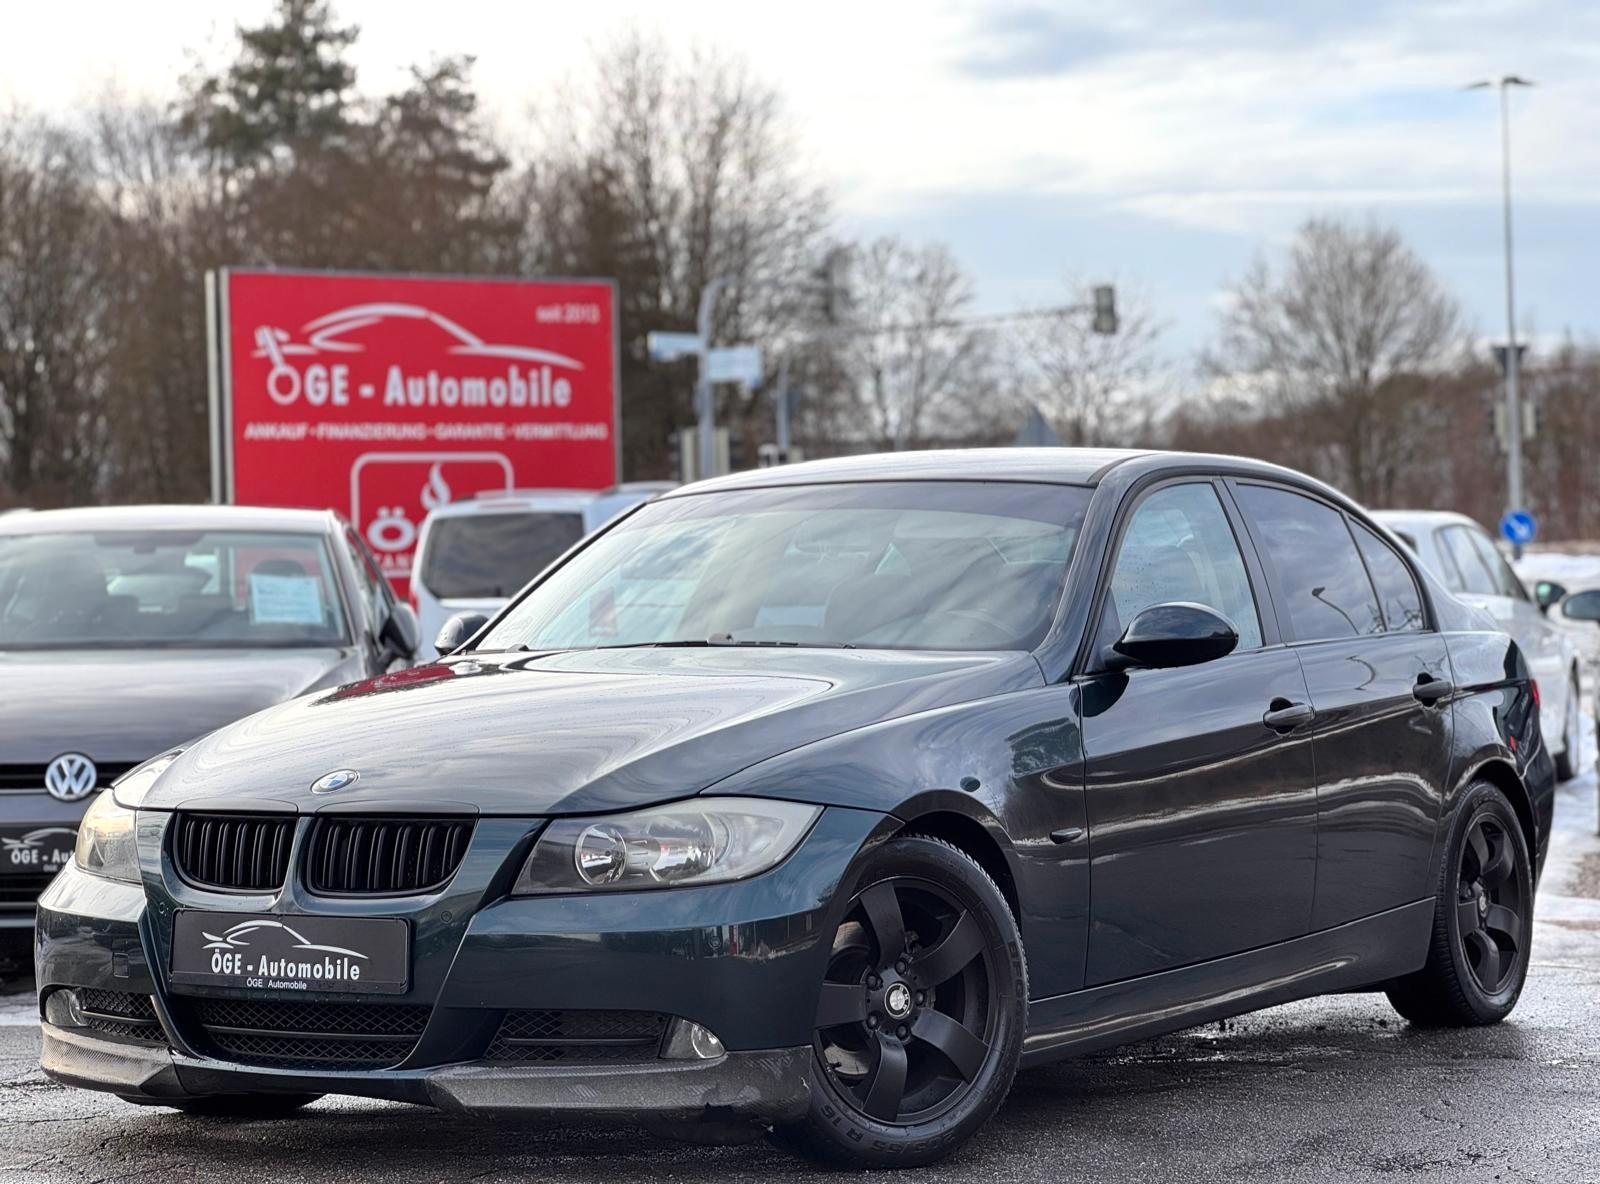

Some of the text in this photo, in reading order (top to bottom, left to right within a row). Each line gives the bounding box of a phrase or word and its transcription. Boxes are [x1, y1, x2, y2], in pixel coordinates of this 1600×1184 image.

[384, 365, 571, 407] Automobile
[46, 754, 96, 800] VW
[211, 949, 242, 974] ÖGE
[258, 955, 360, 980] Automobile
[246, 977, 307, 990] ÖGE Automobile
